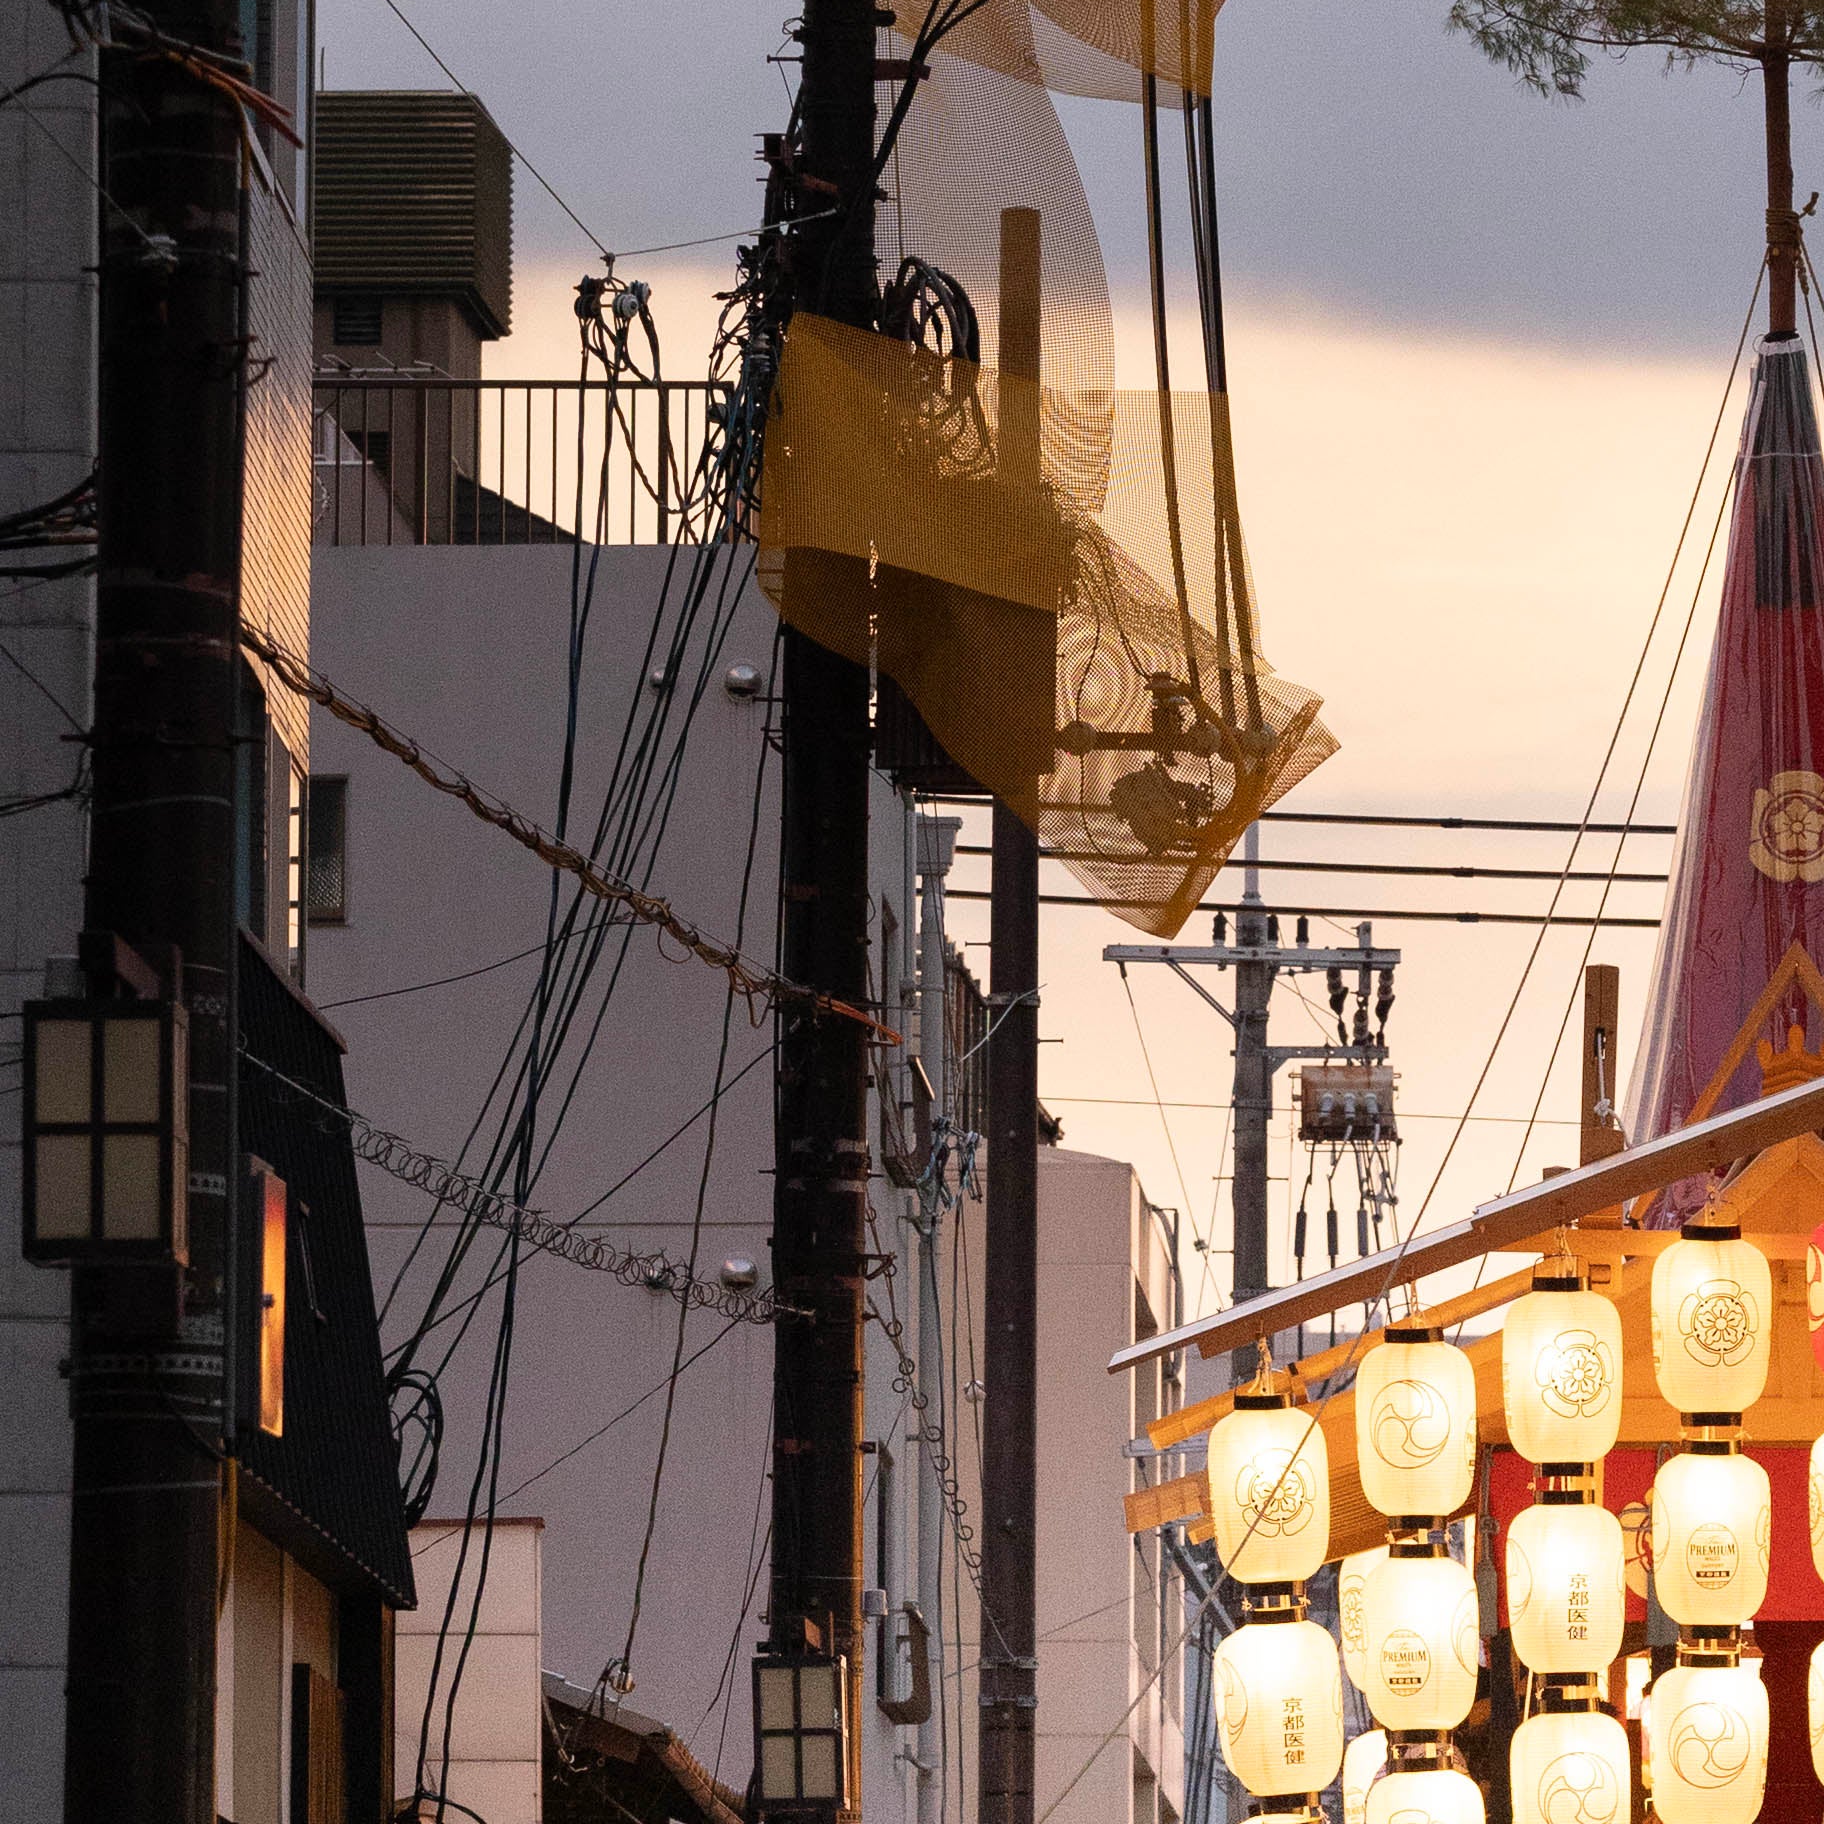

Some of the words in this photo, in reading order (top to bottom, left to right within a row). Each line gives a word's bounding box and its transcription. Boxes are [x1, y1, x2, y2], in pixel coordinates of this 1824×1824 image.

[1690, 1544, 1735, 1556] PREMIUM
[1568, 1573, 1589, 1641] 京都医健
[1383, 1651, 1426, 1663] PREMIUM
[1282, 1697, 1305, 1765] 京都医健
